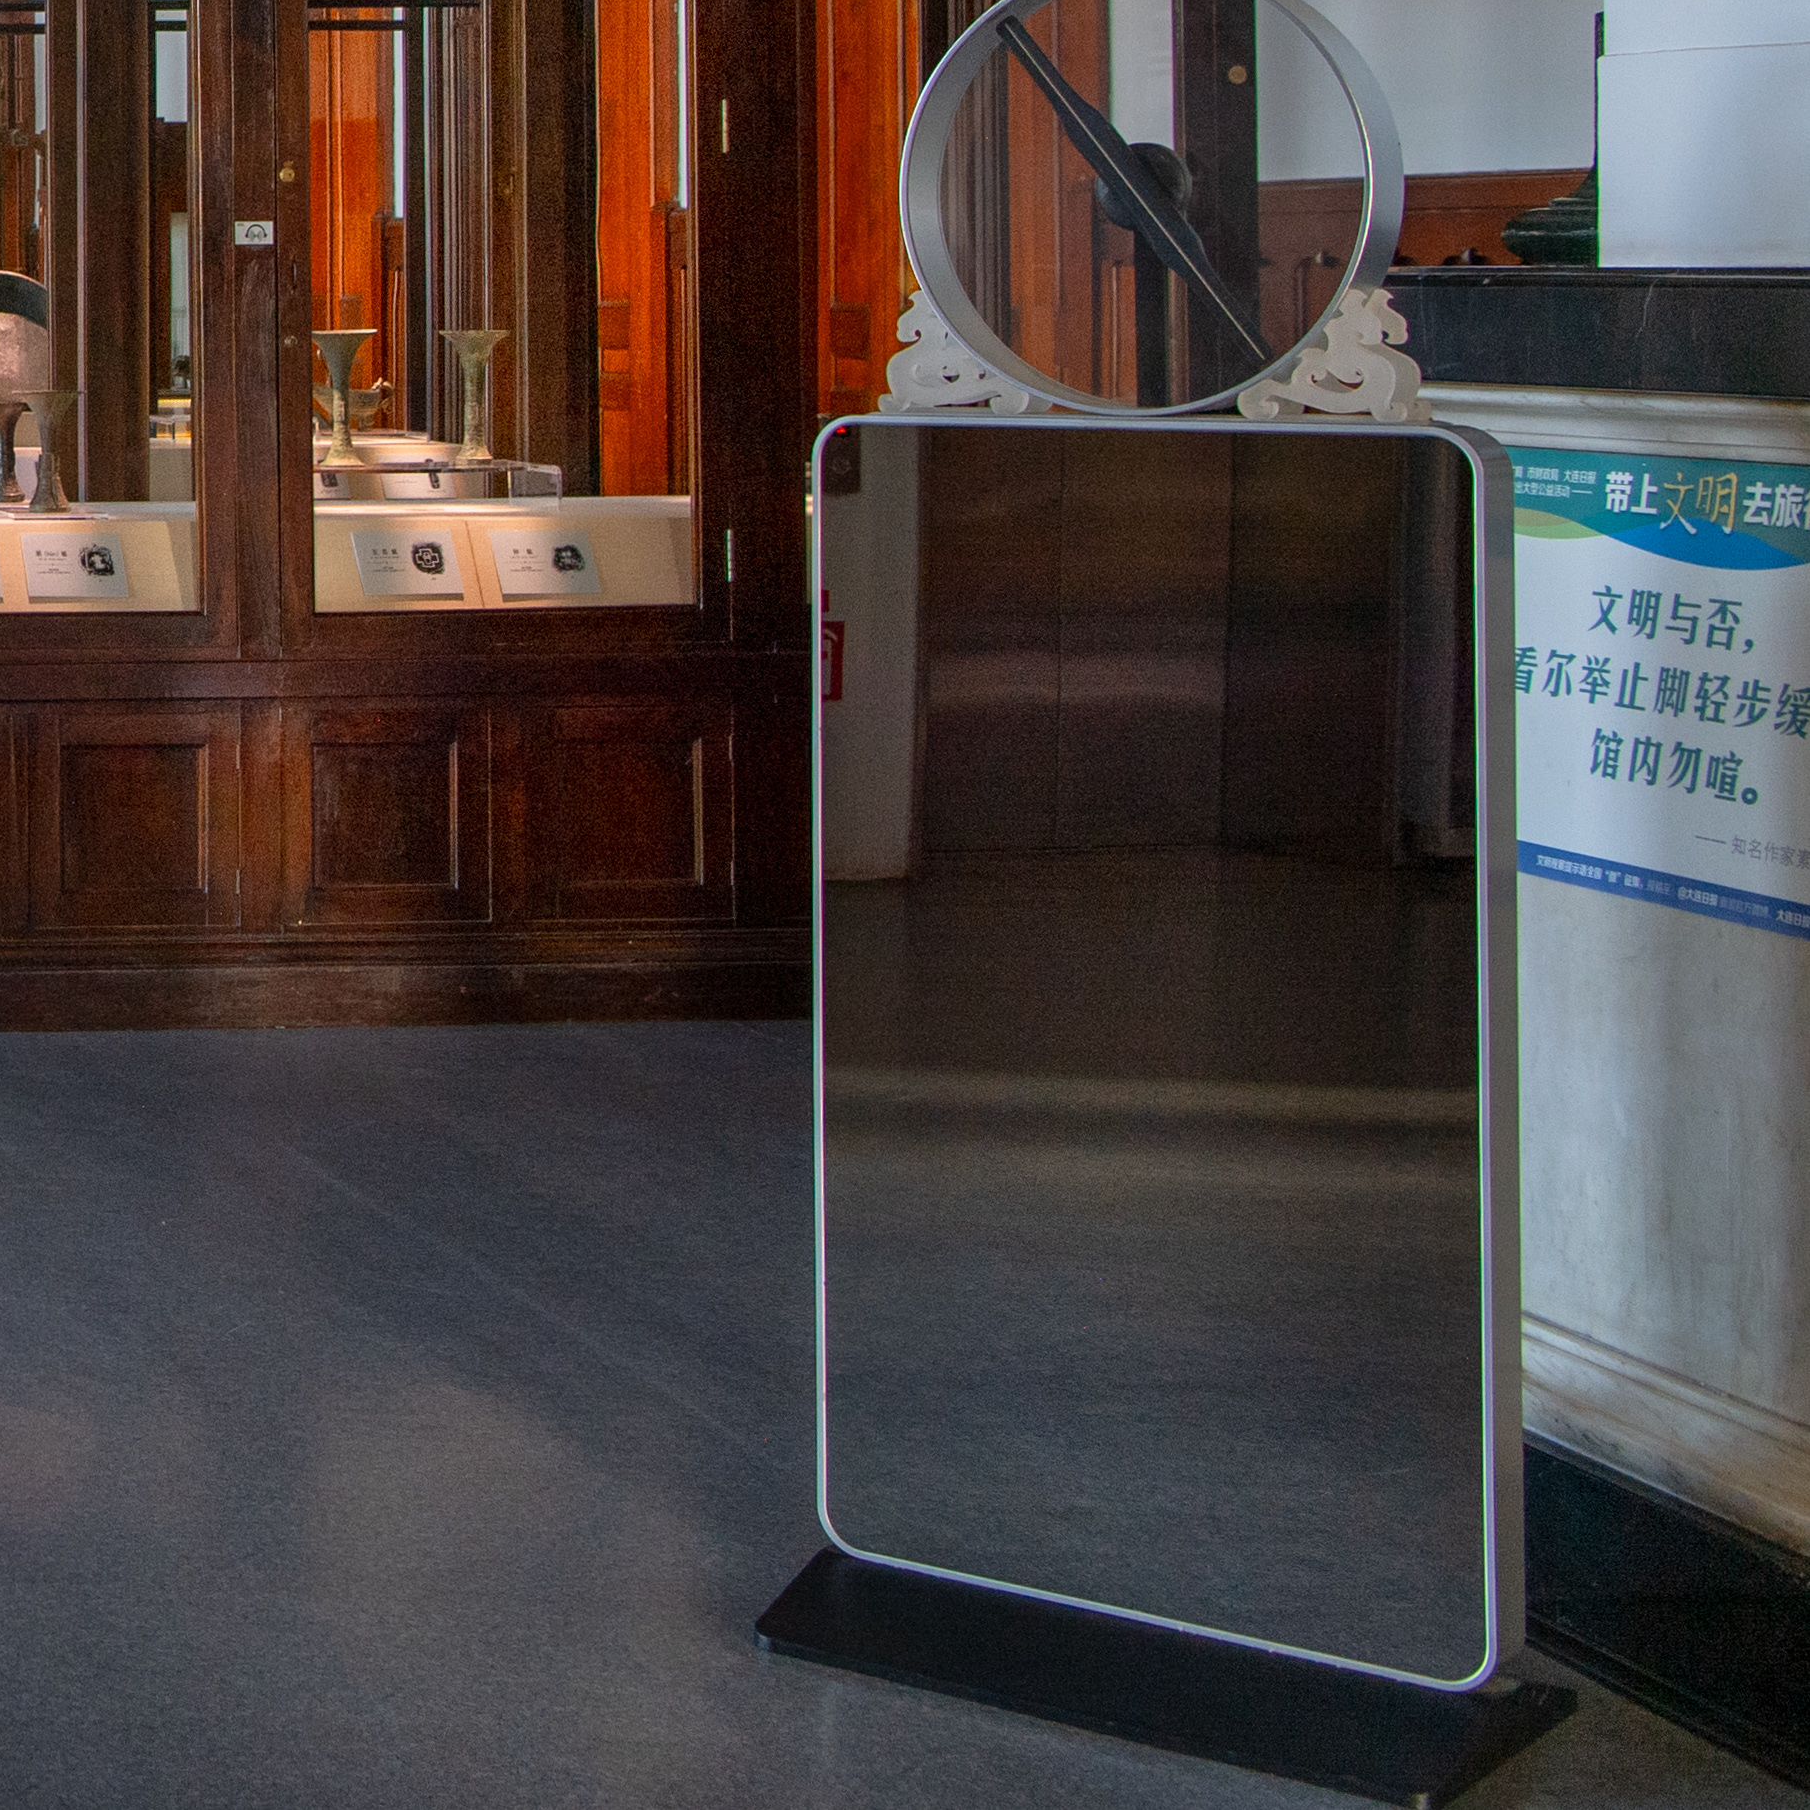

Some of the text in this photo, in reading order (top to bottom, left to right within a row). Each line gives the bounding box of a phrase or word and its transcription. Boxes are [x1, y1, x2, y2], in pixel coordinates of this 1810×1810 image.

[1587, 585, 1755, 654] 文明与否，
[1590, 728, 1758, 805] 馆内勿喧。
